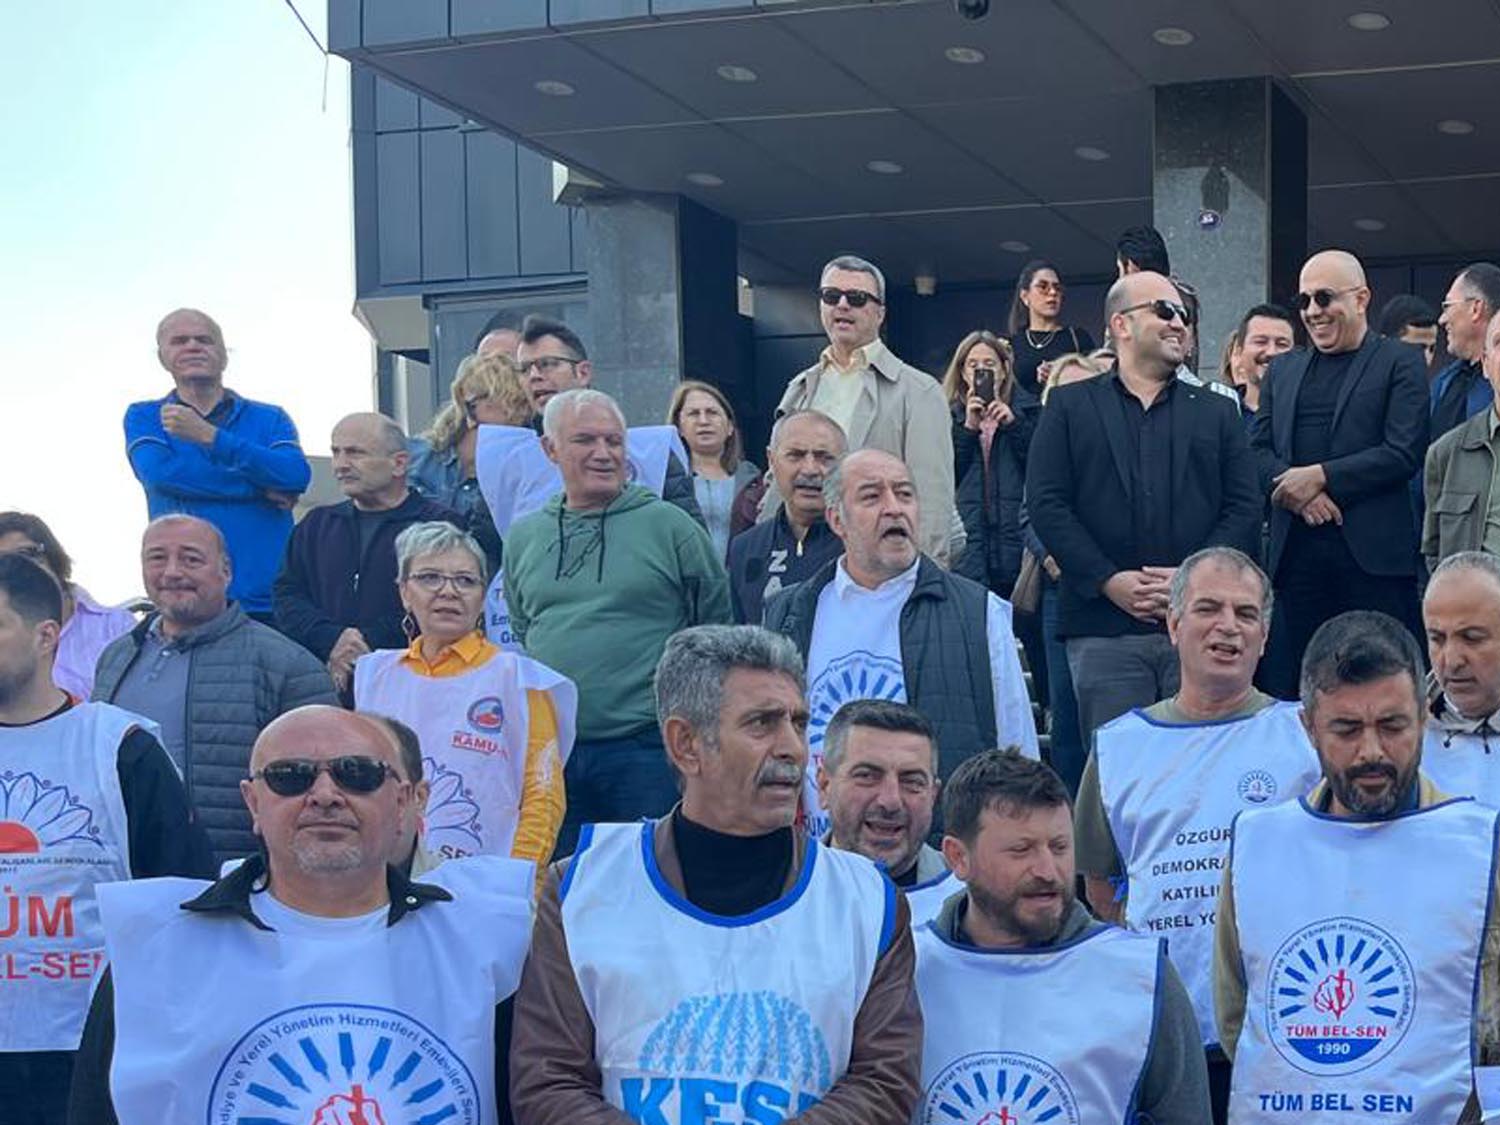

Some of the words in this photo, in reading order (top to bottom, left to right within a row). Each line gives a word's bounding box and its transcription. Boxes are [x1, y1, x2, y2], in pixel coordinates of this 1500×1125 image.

[1147, 915, 1194, 931] YEREL
[239, 1034, 272, 1067] Yerel
[270, 1013, 335, 1039] Yönetim
[339, 1013, 420, 1043] Hizmetleri
[1316, 1043, 1350, 1055] 1990
[1259, 1091, 1303, 1111] TÜM
[1311, 1094, 1354, 1111] BEL
[1362, 1095, 1413, 1113] SEN
